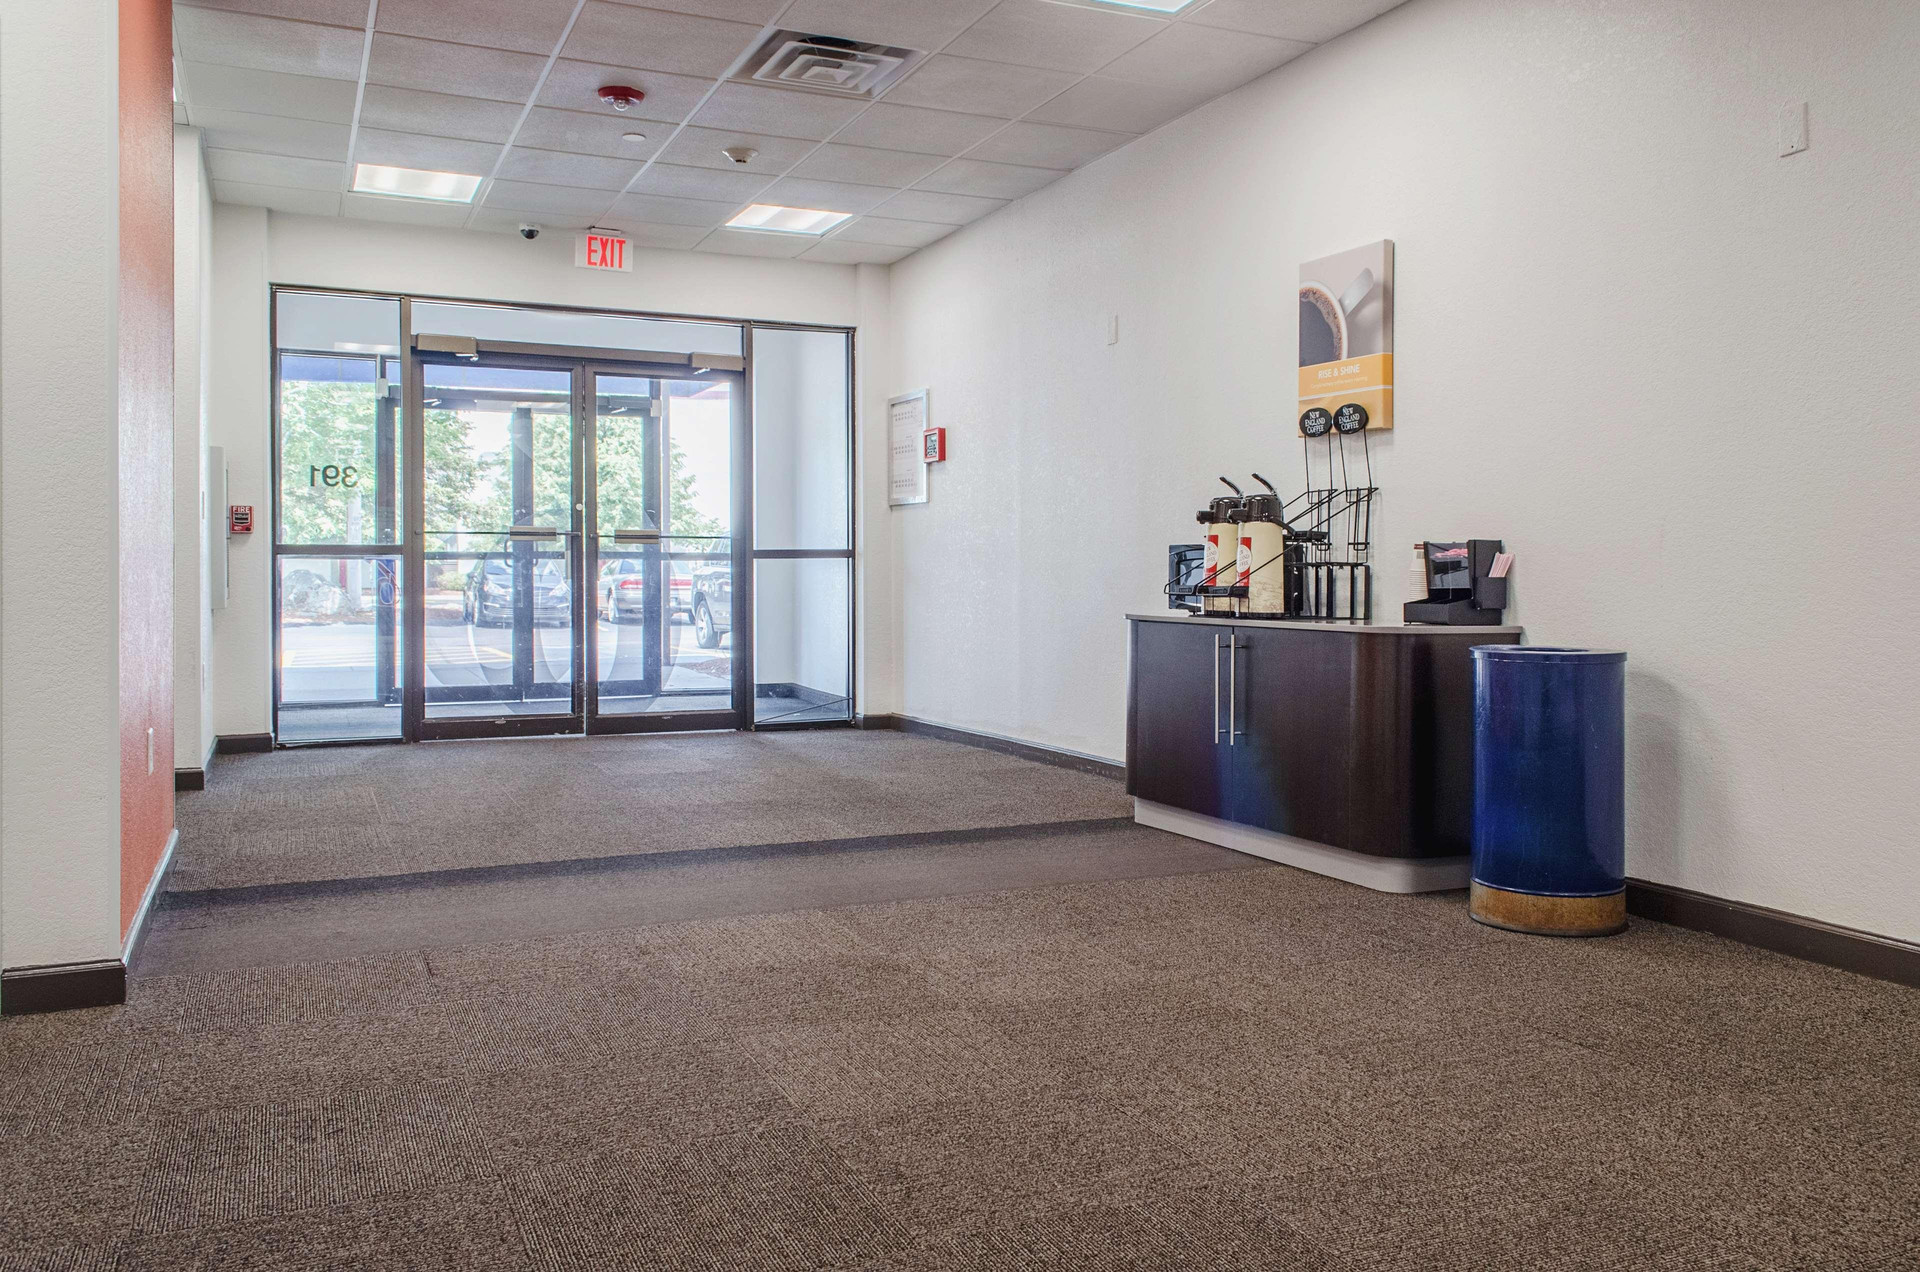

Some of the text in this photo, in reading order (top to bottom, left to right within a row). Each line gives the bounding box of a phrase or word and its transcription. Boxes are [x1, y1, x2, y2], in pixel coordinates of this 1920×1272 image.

[587, 235, 626, 269] EXIT
[1318, 364, 1360, 378] RISE & SHINE
[1304, 417, 1326, 427] ENGLAND
[1338, 413, 1360, 424] ENGLAND
[1306, 424, 1324, 434] COFFEE
[1340, 421, 1359, 431] COFFEE
